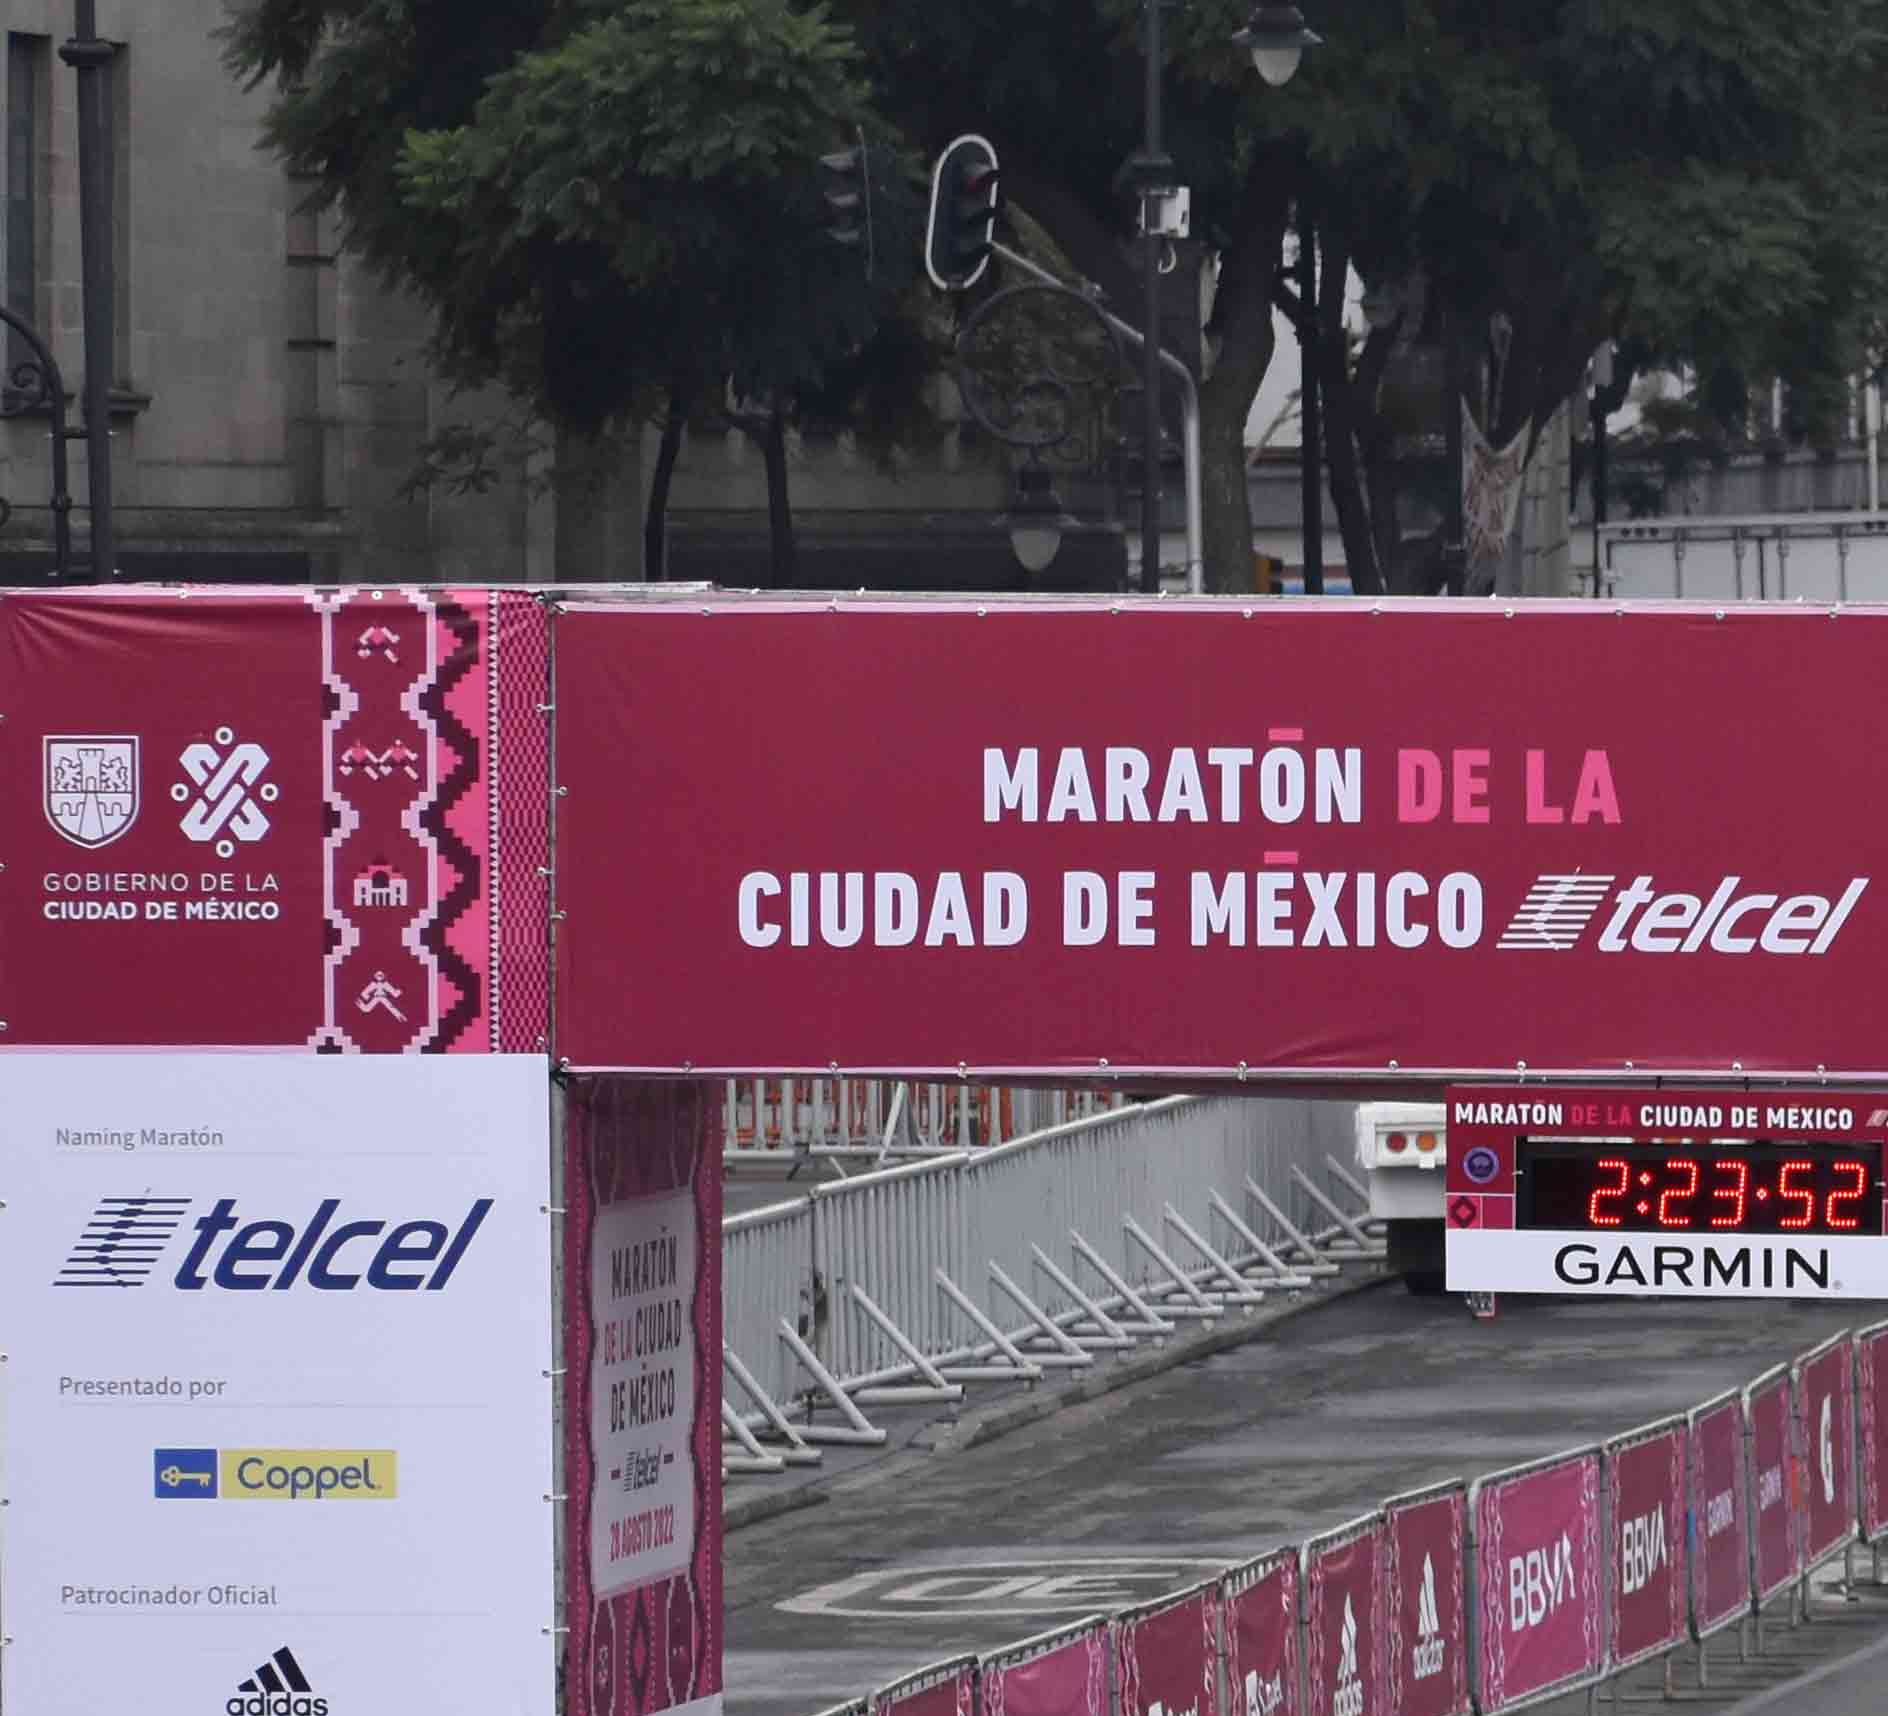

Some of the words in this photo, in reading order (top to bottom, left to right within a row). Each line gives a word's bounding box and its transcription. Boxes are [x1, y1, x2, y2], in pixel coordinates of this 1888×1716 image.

[984, 728, 1361, 824] MARATÓN
[1398, 748, 1490, 824] DE
[1526, 748, 1622, 824] LA
[43, 872, 188, 892] GOBIERNO
[200, 872, 233, 892] DE
[245, 872, 279, 892] LA
[43, 900, 137, 920] CIUDAD
[145, 900, 178, 920] DE
[186, 897, 280, 921] MÉXICO
[738, 871, 1029, 947] CIUDAD
[1063, 871, 1156, 946] DE
[1191, 851, 1483, 948] MÉXICO
[1598, 874, 1870, 954] telcel
[1571, 1104, 1598, 1126] DE
[1607, 1104, 1632, 1126] LA
[1640, 1105, 1722, 1128] CIUDAD
[1731, 1106, 1759, 1129] DE
[56, 1128, 135, 1151] Naming
[140, 1126, 223, 1147] Maratón
[174, 1199, 494, 1290] telcel
[1554, 1244, 1829, 1289] GARMIN
[60, 1377, 182, 1397] Presentado
[189, 1380, 226, 1400] por
[237, 1457, 378, 1499] Coppel
[1622, 1502, 1666, 1593] BBVA
[61, 1585, 200, 1606] Patrocinador
[207, 1585, 277, 1606] Oficial
[1510, 1531, 1576, 1631] BBVA
[226, 1692, 328, 1716] adidas
